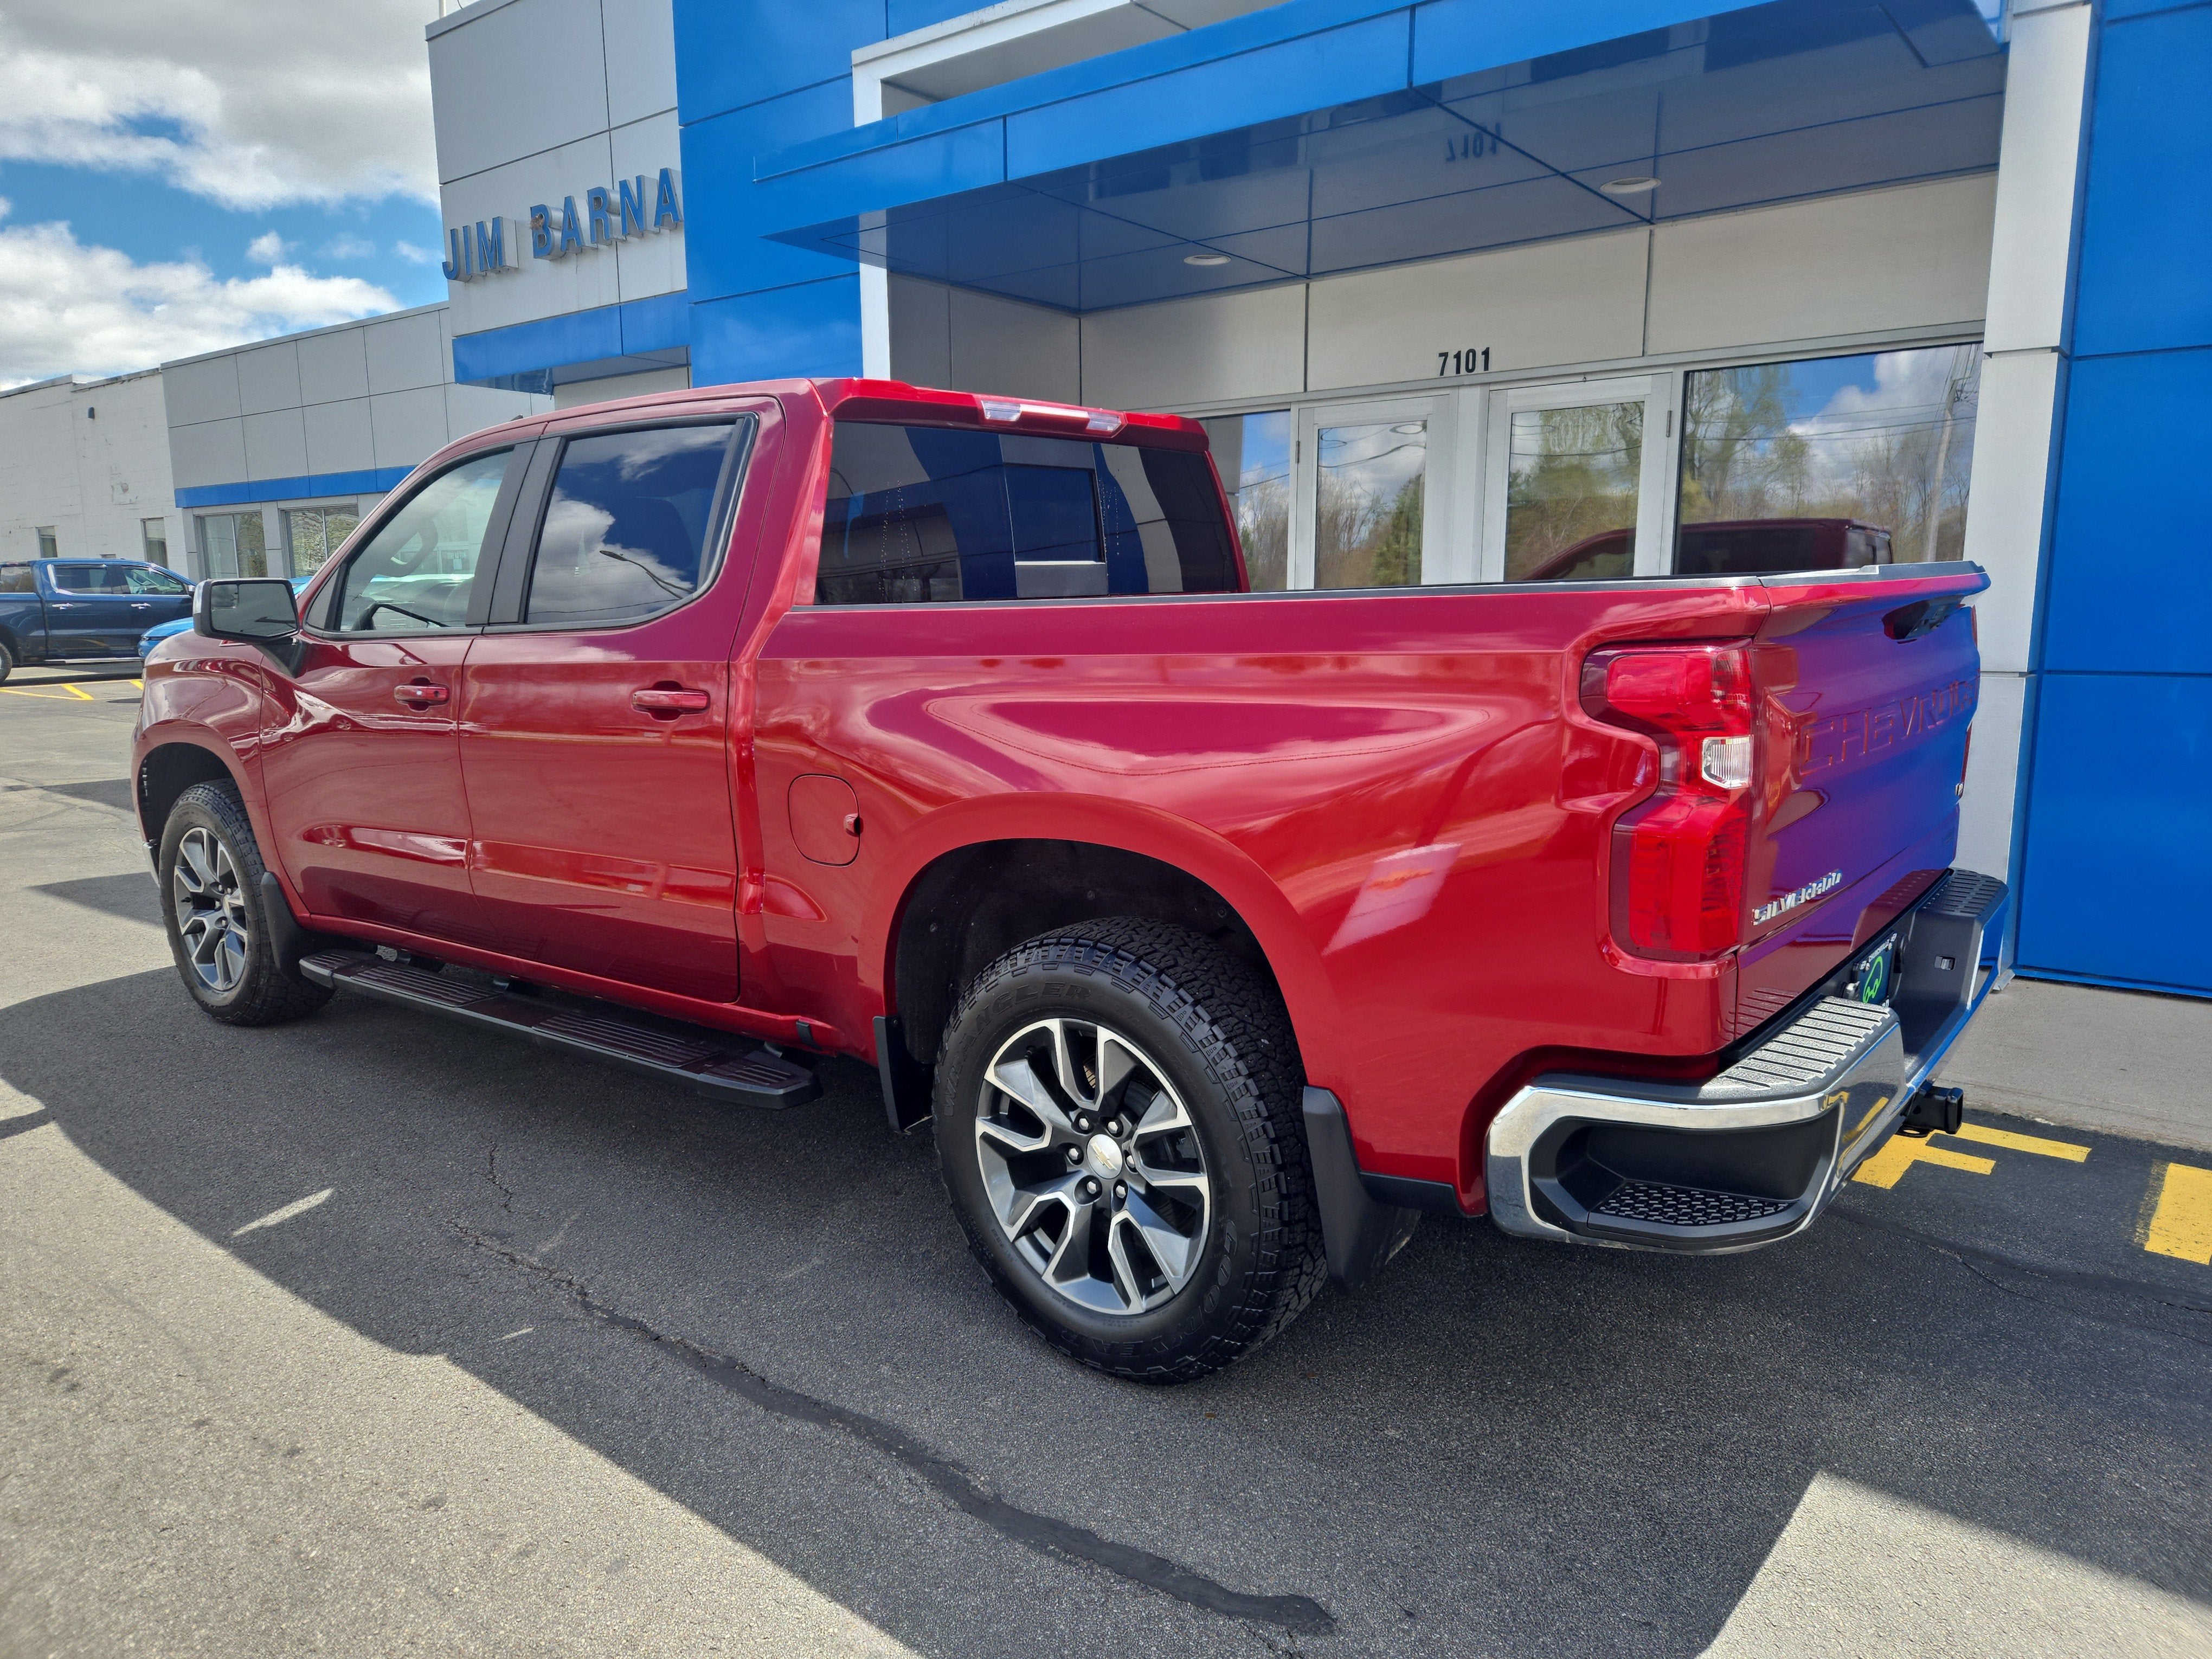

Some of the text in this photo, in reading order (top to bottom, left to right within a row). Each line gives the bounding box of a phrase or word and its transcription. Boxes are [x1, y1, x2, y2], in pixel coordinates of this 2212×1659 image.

[442, 167, 684, 282] JIM BARNA
[1438, 347, 1490, 376] 7101
[1751, 868, 1842, 925] SILVERADO
